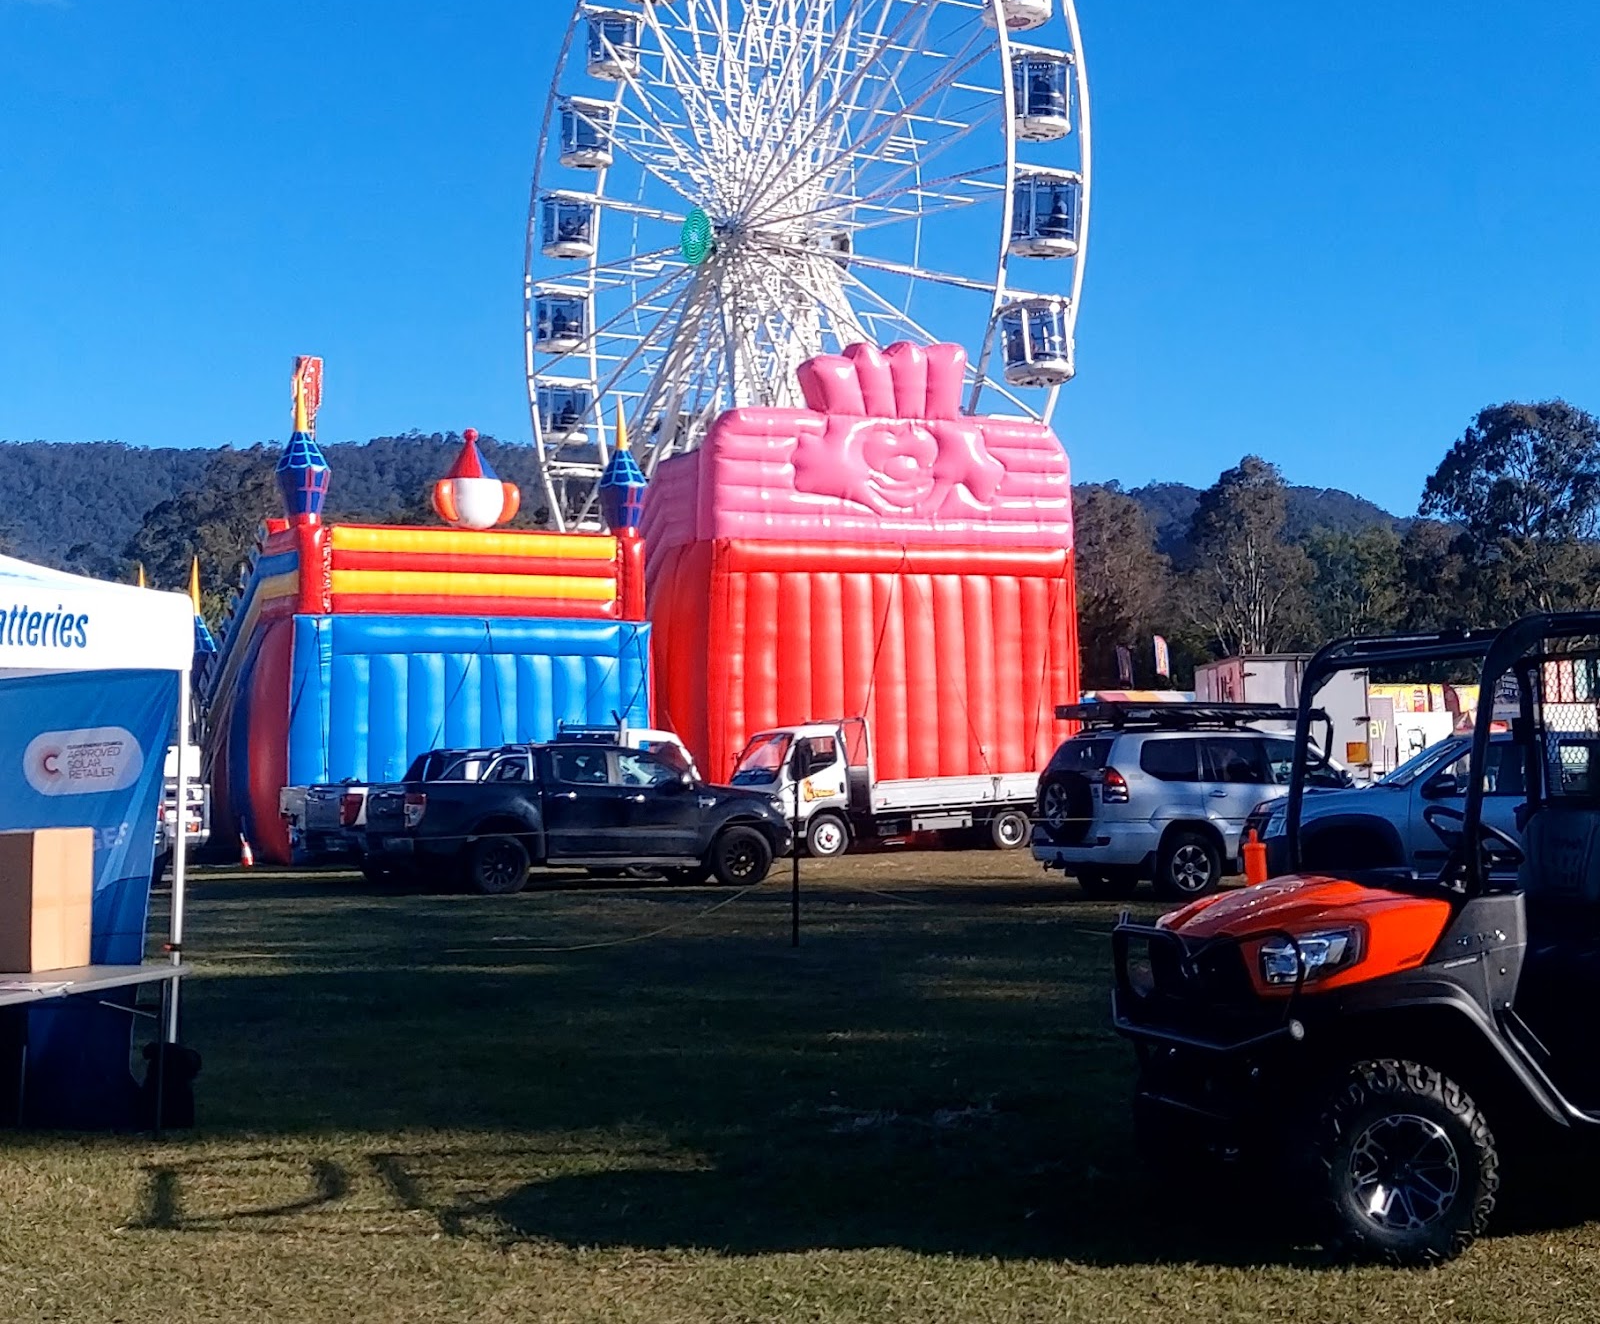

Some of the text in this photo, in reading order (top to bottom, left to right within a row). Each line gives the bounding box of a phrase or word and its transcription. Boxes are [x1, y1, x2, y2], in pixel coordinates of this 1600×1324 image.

[67, 747, 121, 760] APPROVED
[67, 758, 101, 770] SOLAR
[69, 767, 114, 779] RETAILER
